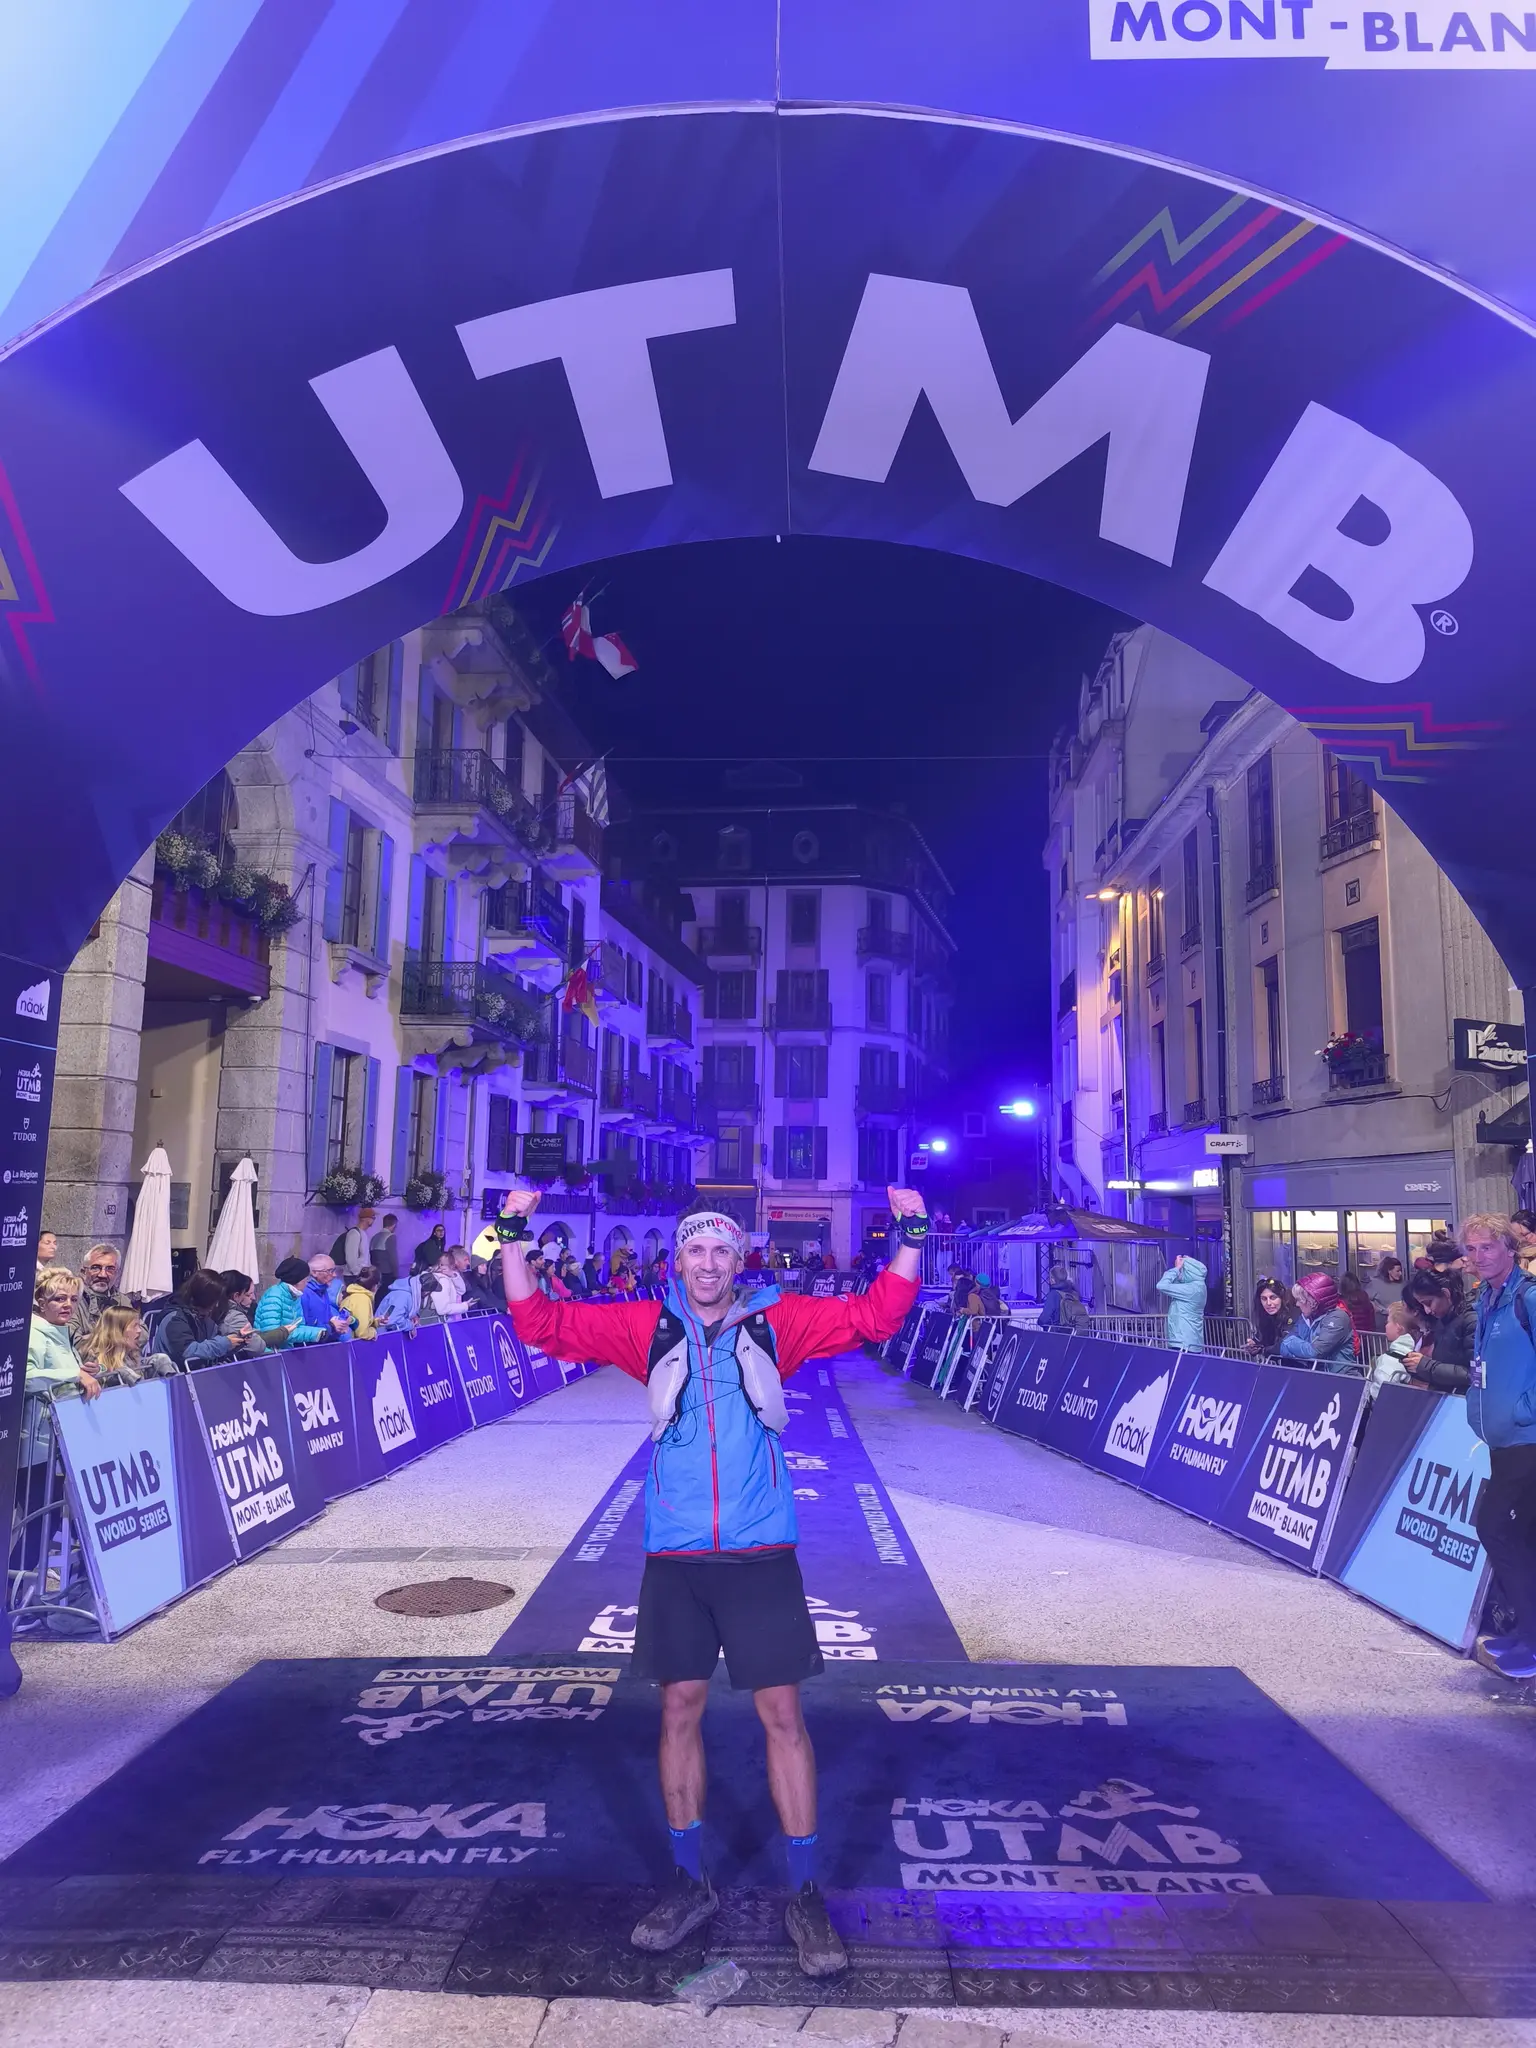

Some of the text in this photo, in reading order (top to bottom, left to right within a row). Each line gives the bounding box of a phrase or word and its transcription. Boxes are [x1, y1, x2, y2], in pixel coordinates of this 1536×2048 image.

[20, 998, 45, 1016] näak
[16, 1076, 41, 1093] UTMB
[13, 1131, 37, 1142] TUDOR
[12, 1170, 39, 1180] La Région
[1404, 1183, 1432, 1192] CRAFT
[2, 1222, 28, 1237] UTMB
[814, 1283, 835, 1292] UTMB
[420, 1379, 453, 1408] SUUNTO
[466, 1374, 496, 1399] TUDOR
[1016, 1388, 1049, 1412] TUDOR
[1061, 1392, 1099, 1421] SUUNTO
[378, 1406, 410, 1442] näak
[1177, 1393, 1242, 1448] HOKA
[1272, 1418, 1309, 1447] HOKA
[209, 1418, 244, 1450] HOKA
[331, 1431, 344, 1448] FLY
[1111, 1416, 1151, 1456] näak
[217, 1436, 284, 1500] UTMB
[1169, 1443, 1229, 1477] FLY HUMAN FLY
[81, 1450, 161, 1515] UTMB
[1259, 1445, 1332, 1509] UTMB
[858, 1494, 883, 1511] YOUR
[99, 1507, 168, 1544] WORLD SERIES
[585, 1522, 620, 1543] YOUR
[863, 1511, 908, 1566] EXTRAORDINARY
[1400, 1513, 1476, 1565] WORLD SERIES
[573, 1543, 608, 1562] MEET
[357, 1682, 613, 1709] UTMB
[933, 1686, 1055, 1698] HUMAN
[1066, 1688, 1118, 1698] FLY
[471, 1706, 605, 1722] HOKA
[876, 1698, 1128, 1726] HOKA
[889, 1797, 1052, 1820] HOKA
[221, 1802, 547, 1842] HOKA
[891, 1819, 1243, 1866] UTMB
[197, 1848, 277, 1865] FLY
[276, 1847, 456, 1865] HUMAN
